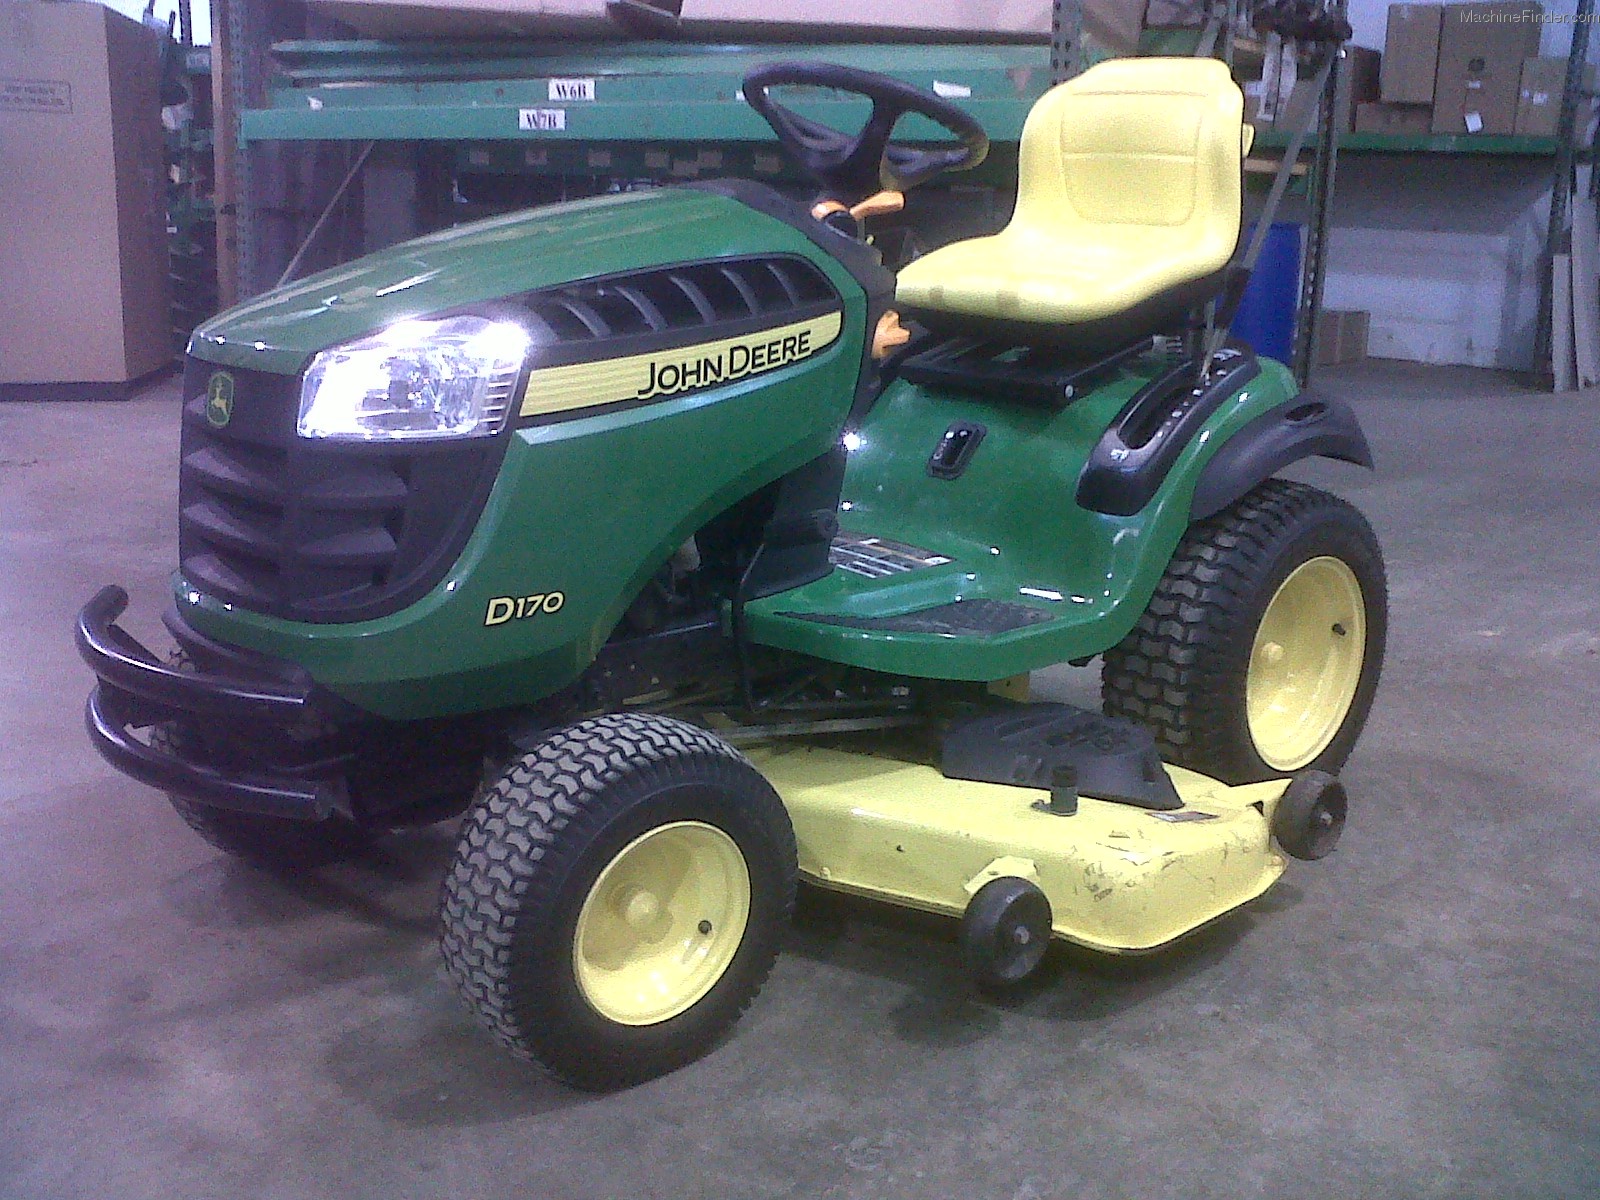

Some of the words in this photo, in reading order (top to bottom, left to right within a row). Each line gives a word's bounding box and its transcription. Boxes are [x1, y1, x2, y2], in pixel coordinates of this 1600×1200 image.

[556, 83, 586, 98] W6B
[526, 112, 557, 129] W7B
[637, 355, 723, 396] JOHN
[729, 330, 812, 376] DEERE
[484, 591, 565, 626] D170
